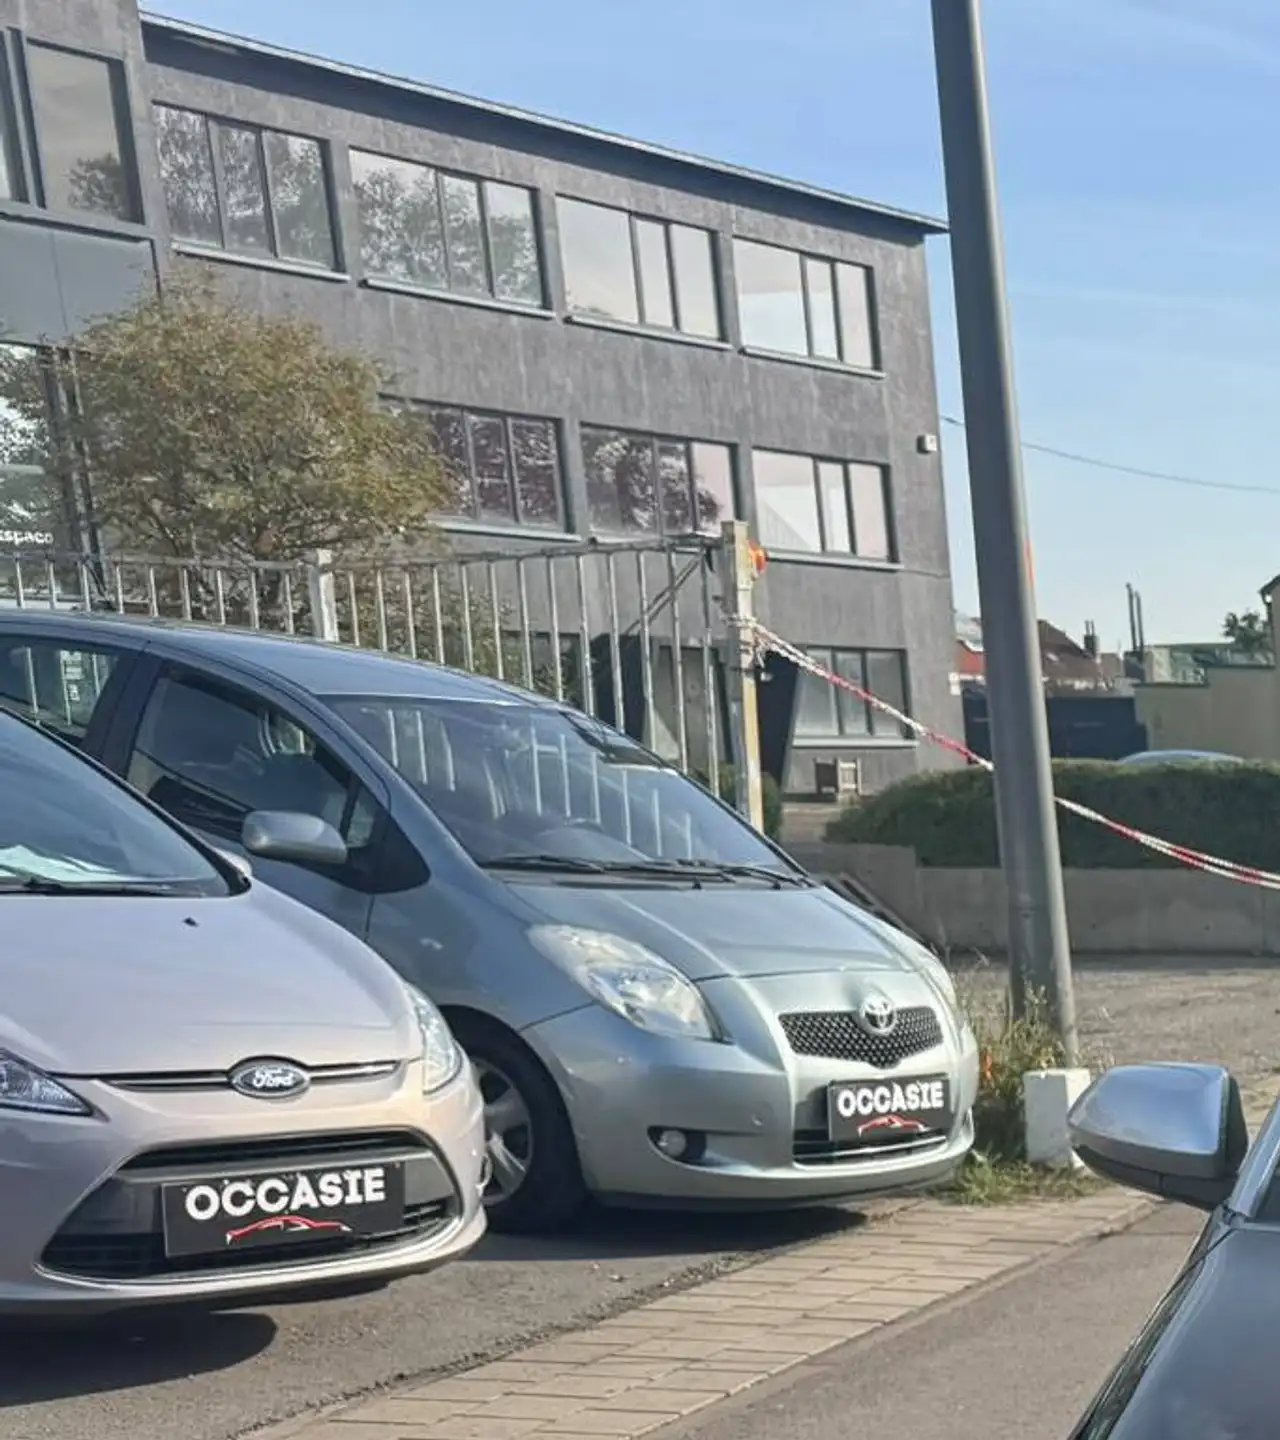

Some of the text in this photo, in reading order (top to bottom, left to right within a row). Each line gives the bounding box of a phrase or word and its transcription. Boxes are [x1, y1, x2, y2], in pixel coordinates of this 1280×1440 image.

[253, 1067, 294, 1088] Ford
[837, 1081, 944, 1117] OCCASIE
[185, 1167, 386, 1220] OCCASIE
